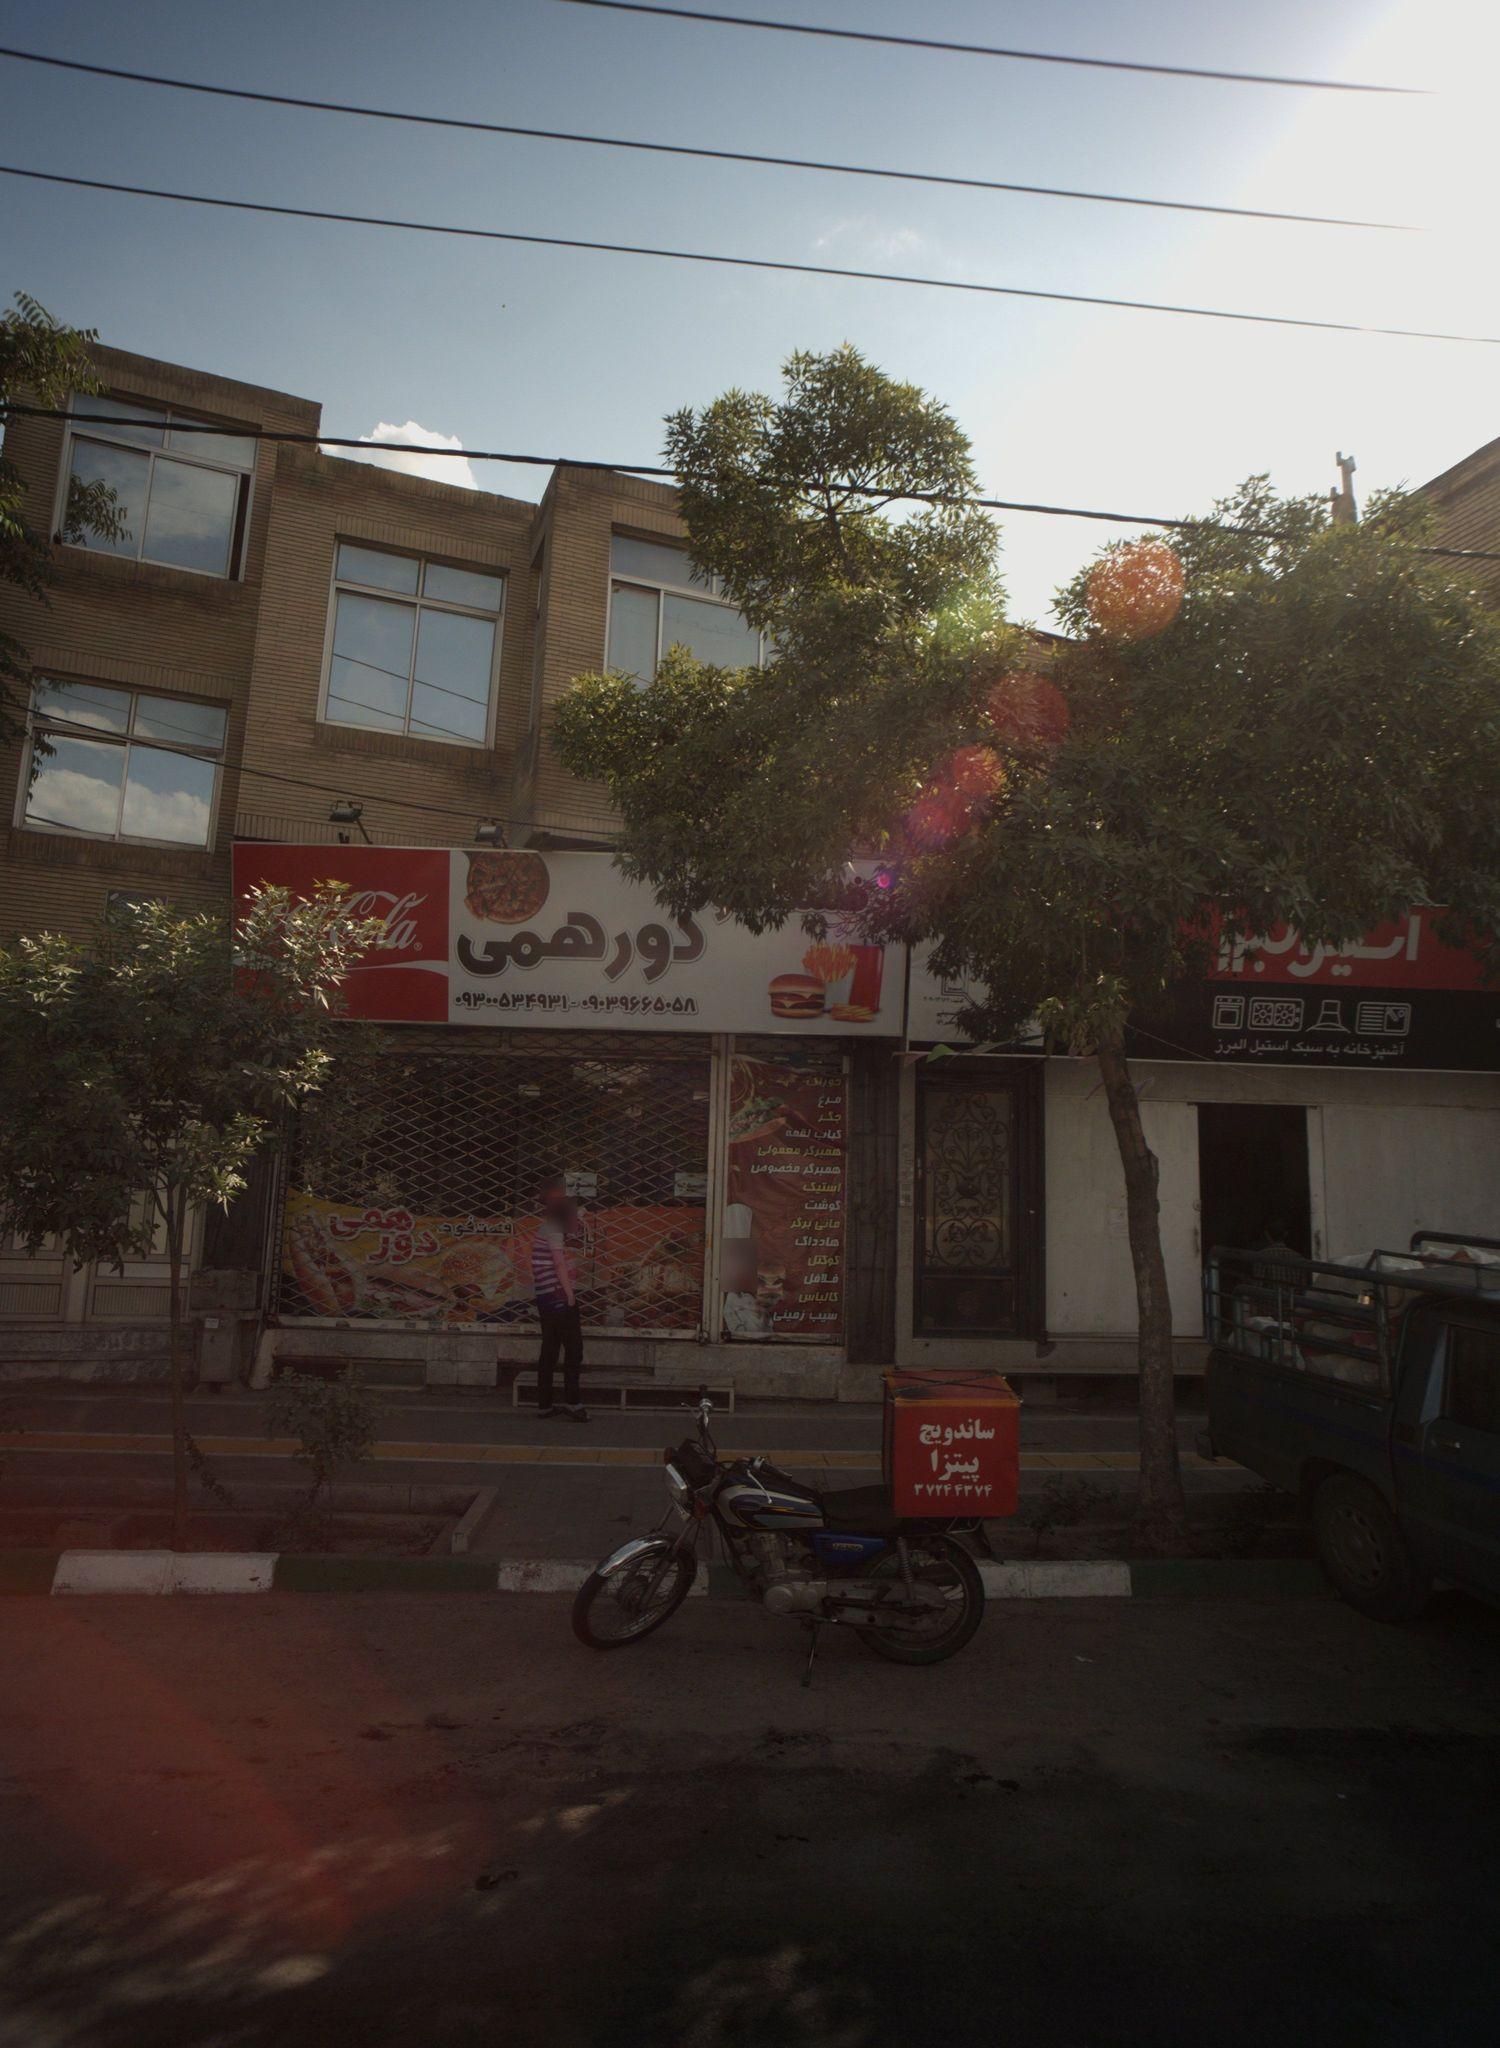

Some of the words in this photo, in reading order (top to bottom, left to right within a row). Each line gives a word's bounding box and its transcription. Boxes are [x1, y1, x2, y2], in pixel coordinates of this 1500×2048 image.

[1214, 1037, 1248, 1055] البرز
[1249, 1039, 1289, 1056] استیل
[1291, 1041, 1323, 1057] سبک
[1325, 1043, 1341, 1058] به
[817, 1095, 842, 1108] مرغ
[814, 1129, 842, 1141] کباب
[757, 1145, 801, 1156] معمولی
[802, 1145, 842, 1157] همبرگر
[750, 1163, 800, 1174] مخصوص
[802, 1164, 842, 1175] همبرگر
[802, 1181, 842, 1193] استیک
[803, 1272, 839, 1285] فلافل
[772, 1310, 807, 1322] زمینی
[809, 1312, 838, 1323] سیب
[918, 1418, 996, 1445] ساندویچ
[930, 1448, 981, 1482] پیتزا
